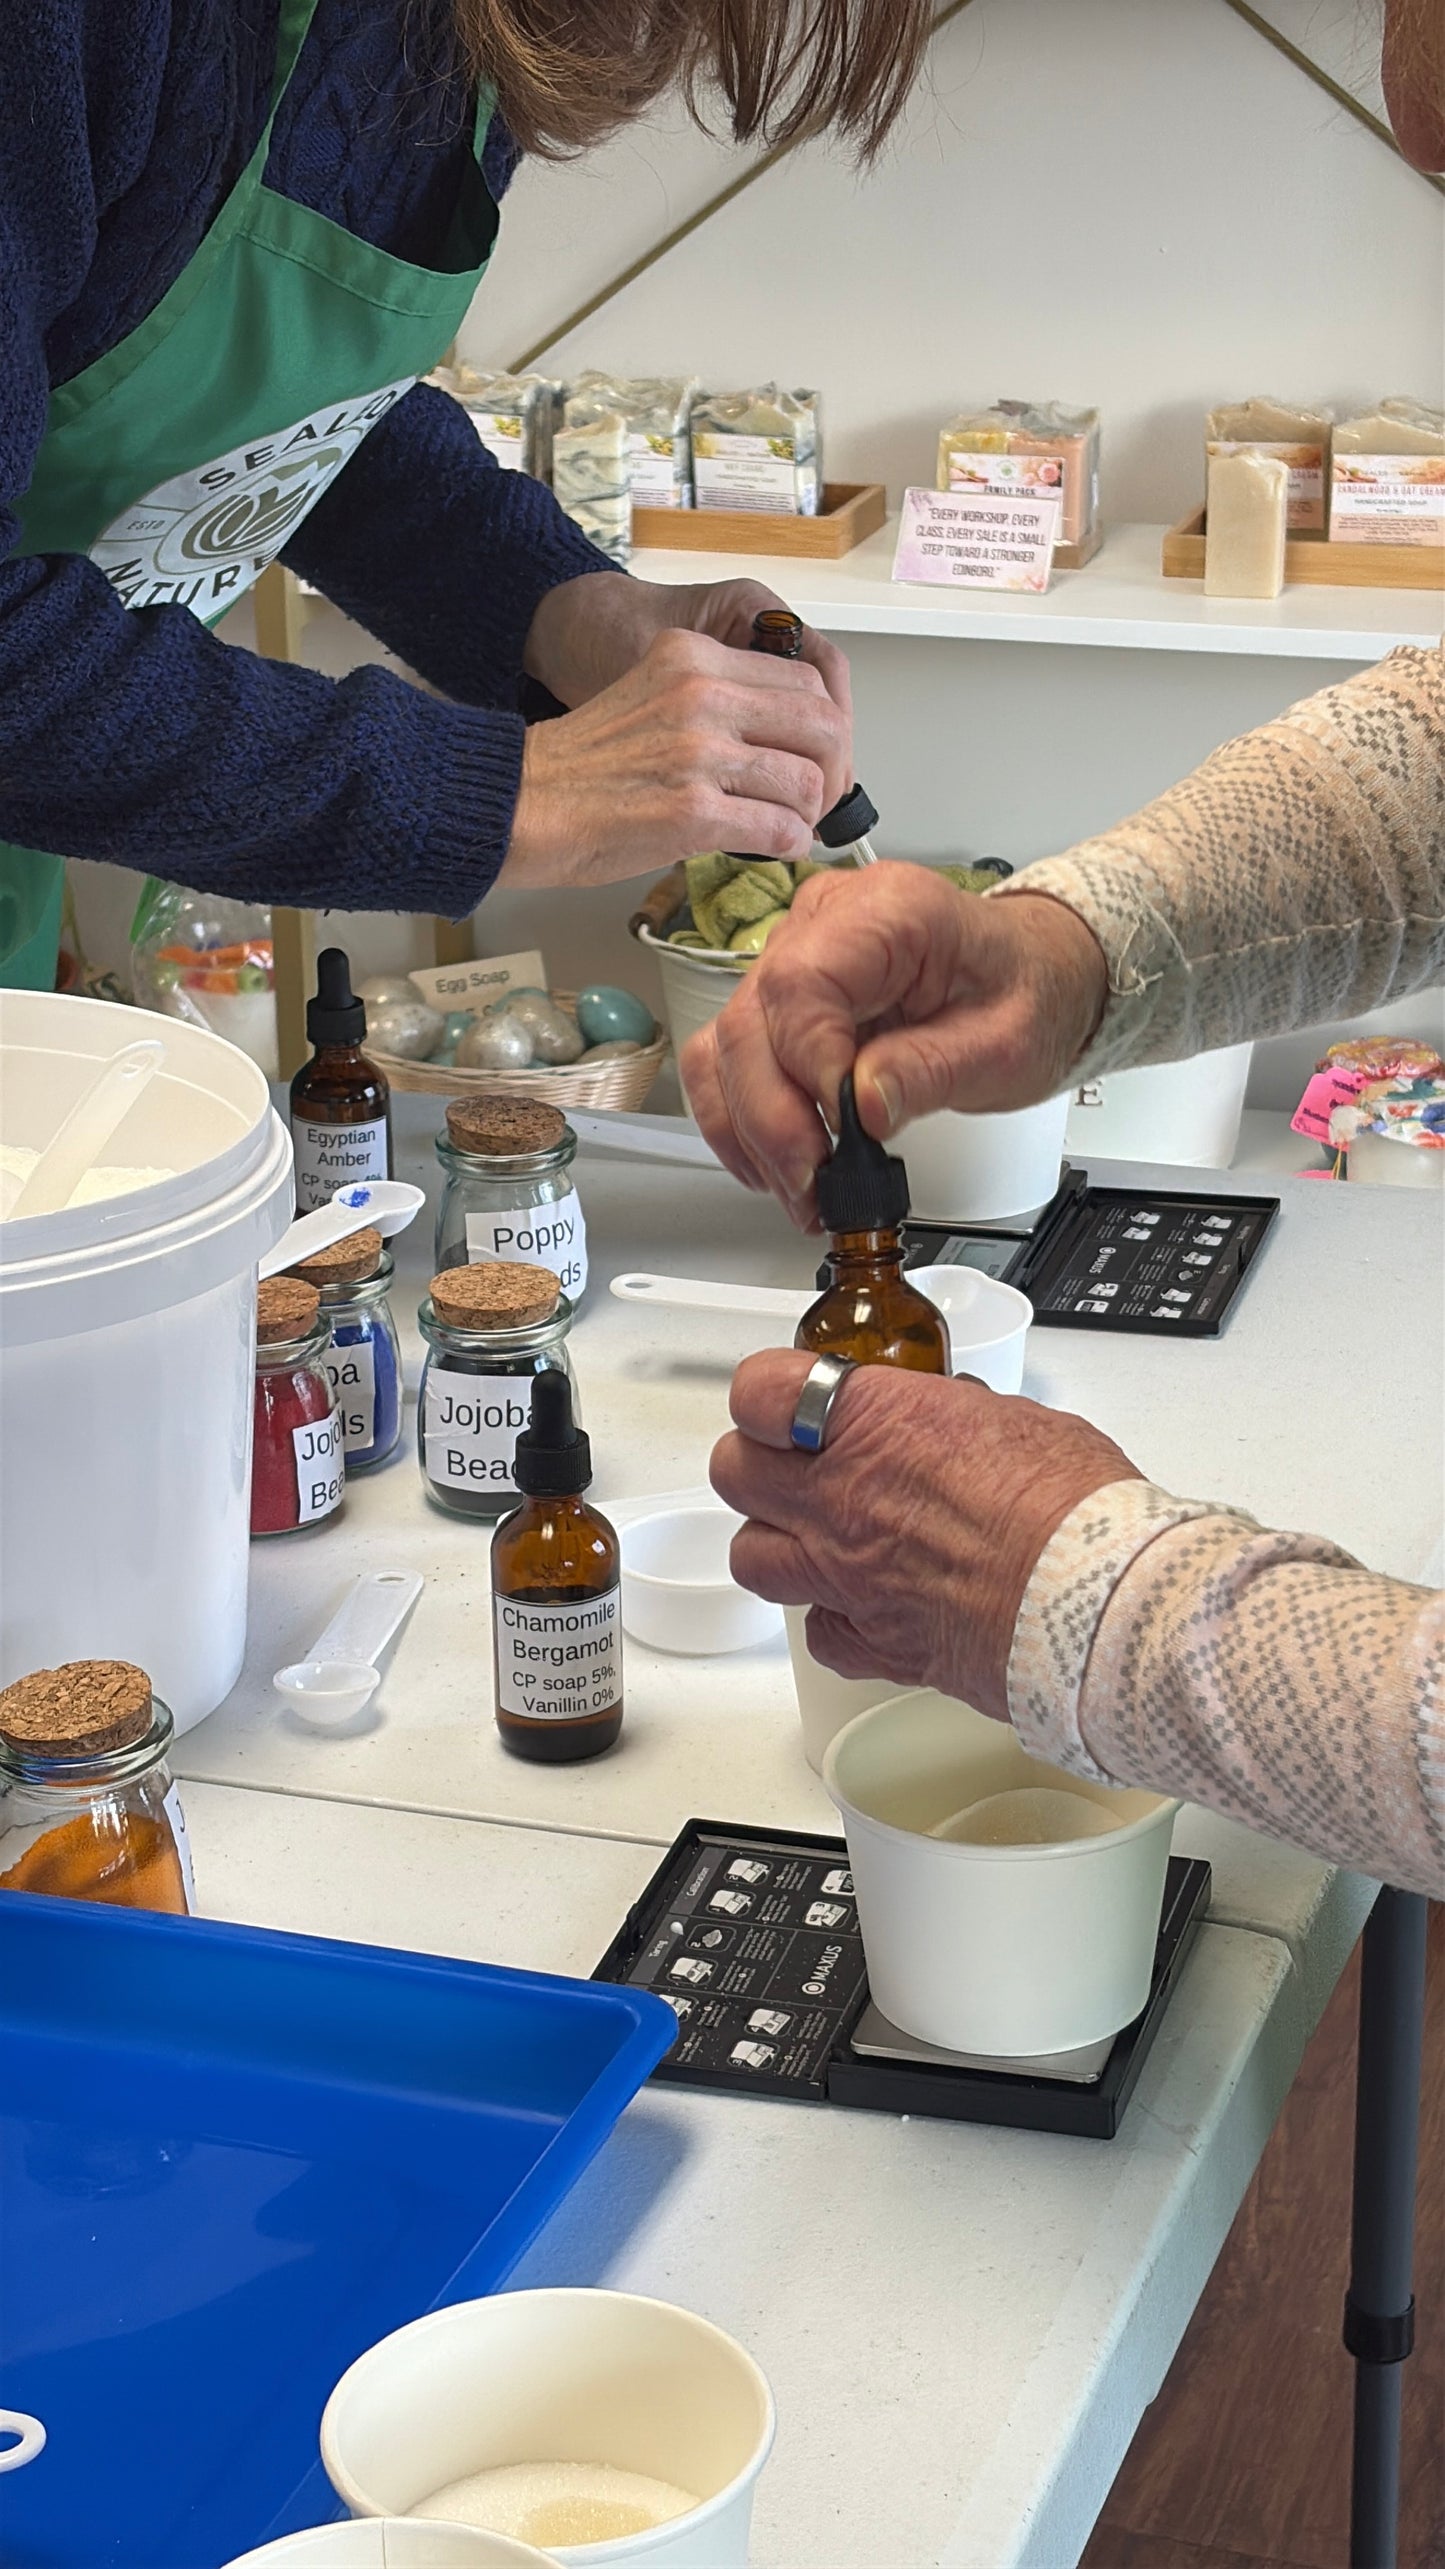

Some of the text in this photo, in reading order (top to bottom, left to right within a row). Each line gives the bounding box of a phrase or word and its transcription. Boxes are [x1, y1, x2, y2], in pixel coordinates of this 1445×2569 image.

[984, 485, 1037, 496] FAMILY PACK
[1012, 514, 1040, 527] EVERY
[946, 527, 974, 541] EVERY
[976, 529, 998, 543] SALE
[999, 531, 1009, 543] IS
[1010, 533, 1016, 543] A
[1017, 533, 1046, 546] SMALL
[921, 543, 1035, 563] STEP TOWARD A STRONGER
[105, 546, 280, 607] NATURE
[435, 970, 510, 994] Egg Soap
[307, 1128, 376, 1148] Egyptian
[317, 1151, 371, 1166] Amber
[301, 1172, 319, 1186] CP
[493, 1217, 574, 1255] Poppy
[447, 1449, 517, 1480] Bea
[502, 1602, 615, 1633] Chamomile
[513, 1631, 614, 1667] Bergamot
[512, 1671, 537, 1689] CP
[542, 1675, 587, 1692] soap
[522, 1686, 614, 1714] Vanillin 0%
[810, 1944, 843, 1981] MAXUS
